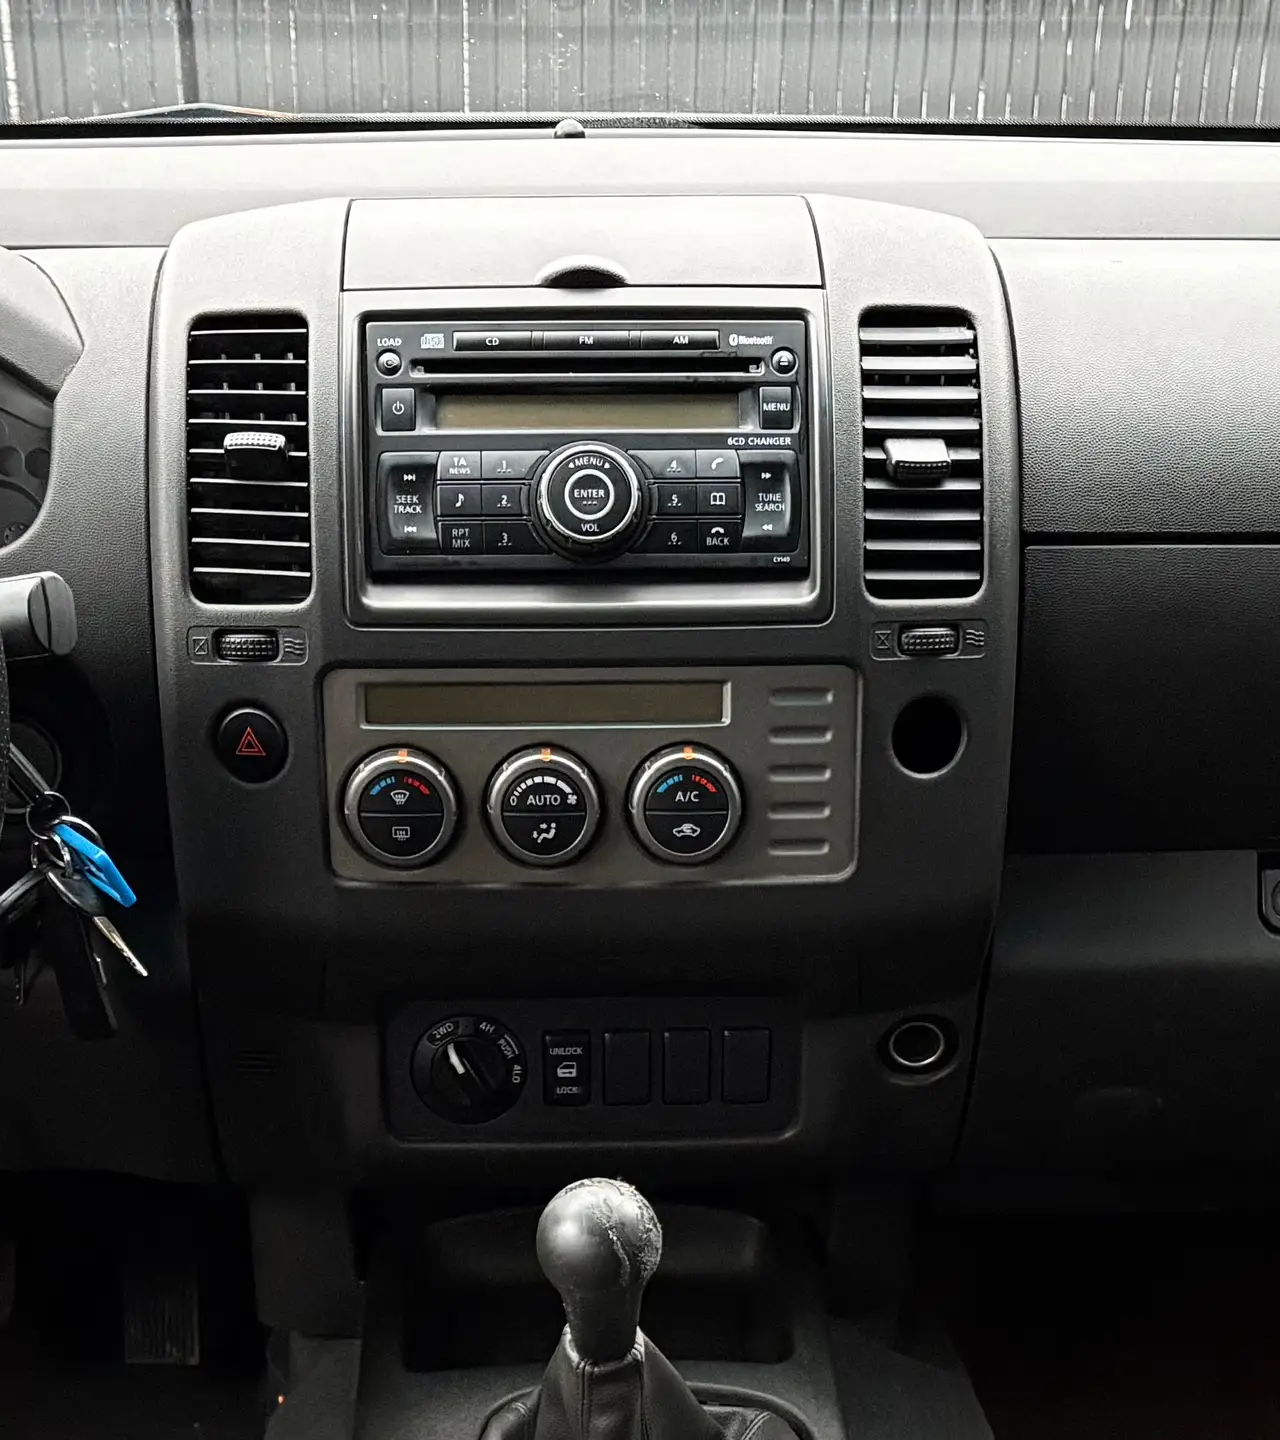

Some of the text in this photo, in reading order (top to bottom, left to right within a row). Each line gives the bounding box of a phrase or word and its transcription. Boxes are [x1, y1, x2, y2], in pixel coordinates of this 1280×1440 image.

[377, 337, 402, 347] LOAD
[485, 337, 499, 346] CD
[579, 336, 594, 345] FM
[673, 335, 689, 344] AM
[738, 335, 774, 345] Bluetooth
[762, 402, 791, 412] MENU
[727, 437, 792, 446] 6CD CHANGER
[453, 457, 467, 467] TA
[575, 455, 604, 467] MENU
[449, 467, 471, 475] NEWS
[574, 489, 605, 499] ENTER
[757, 492, 782, 502] TUNE
[396, 495, 419, 504] SEEK
[393, 504, 422, 514] TRACK
[755, 502, 785, 512] SEARCH
[452, 528, 469, 537] RPT
[581, 523, 600, 532] VOL
[452, 539, 470, 548] MIX
[706, 537, 730, 546] BACK
[526, 793, 561, 808] AUTO
[675, 789, 700, 804] A/C
[431, 1021, 455, 1040] 2WD
[478, 1020, 497, 1035] 4H
[496, 1037, 516, 1061] PUSH
[549, 1047, 584, 1056] UNLOCK
[511, 1063, 525, 1085] 4LO
[556, 1086, 582, 1095] LOCK
